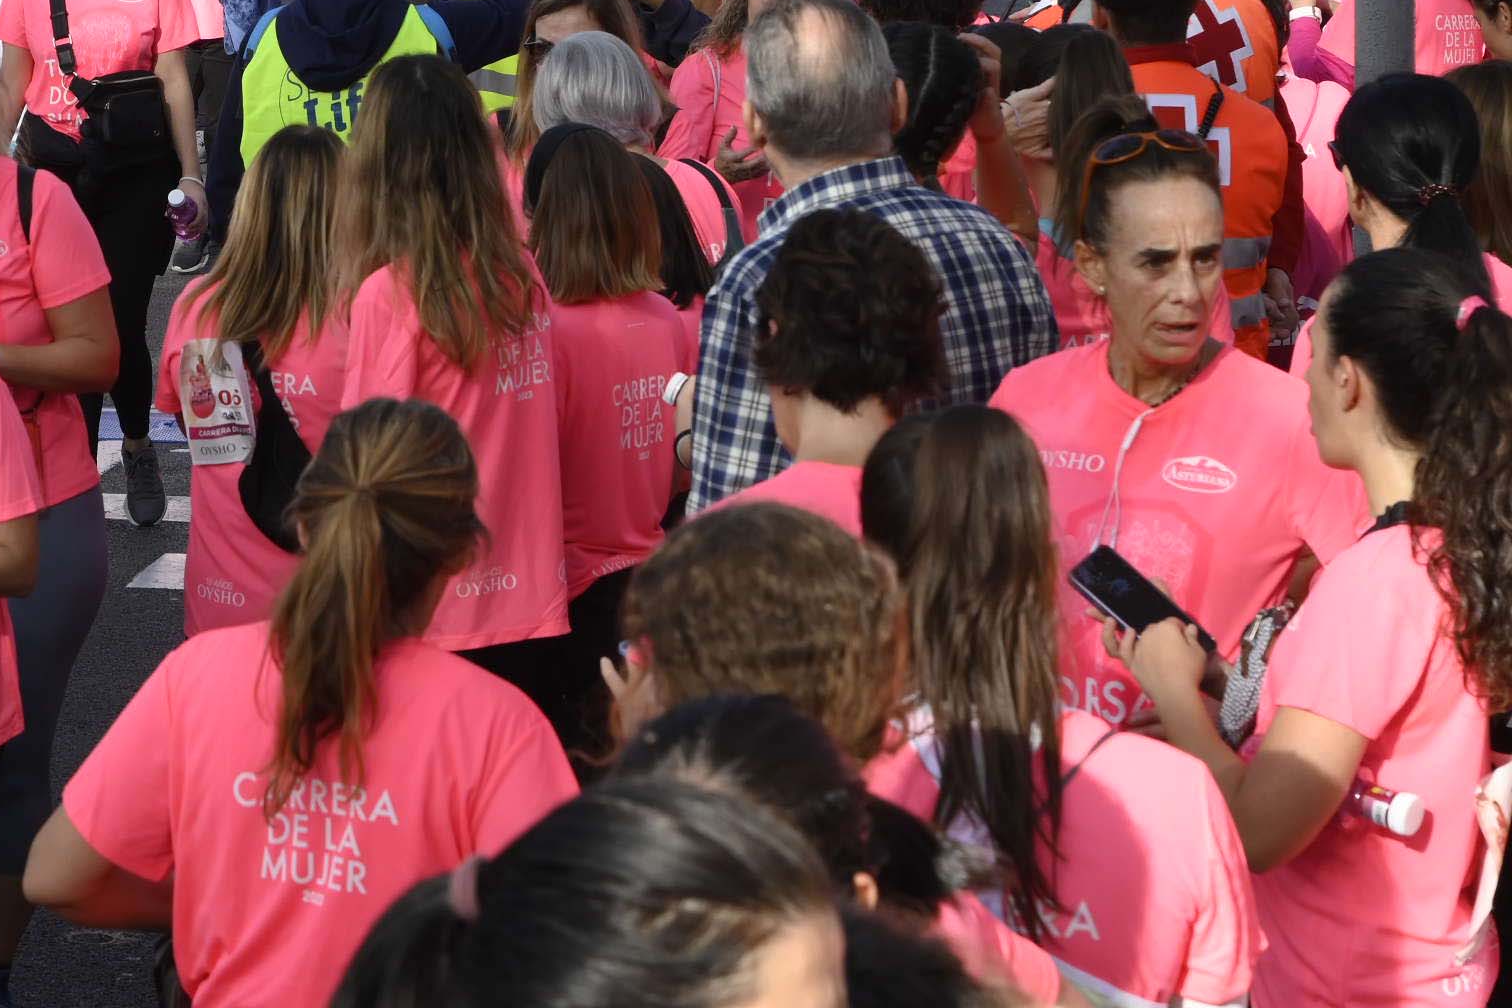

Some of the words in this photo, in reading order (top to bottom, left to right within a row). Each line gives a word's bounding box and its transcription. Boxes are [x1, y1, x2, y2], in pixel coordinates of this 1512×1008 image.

[1434, 14, 1481, 31] CARRERA
[1445, 31, 1460, 48] DE
[1463, 31, 1475, 47] LA
[526, 341, 545, 360] LA
[495, 360, 551, 396] MUJER
[612, 376, 666, 407] CARRER
[621, 404, 641, 428] DE
[646, 399, 663, 421] LA
[620, 423, 664, 449] MUJER
[197, 583, 246, 607] OYSHO
[455, 574, 517, 599] OYSHO
[267, 812, 310, 849] DE
[324, 816, 361, 857] LA
[260, 845, 368, 894] MUJER
